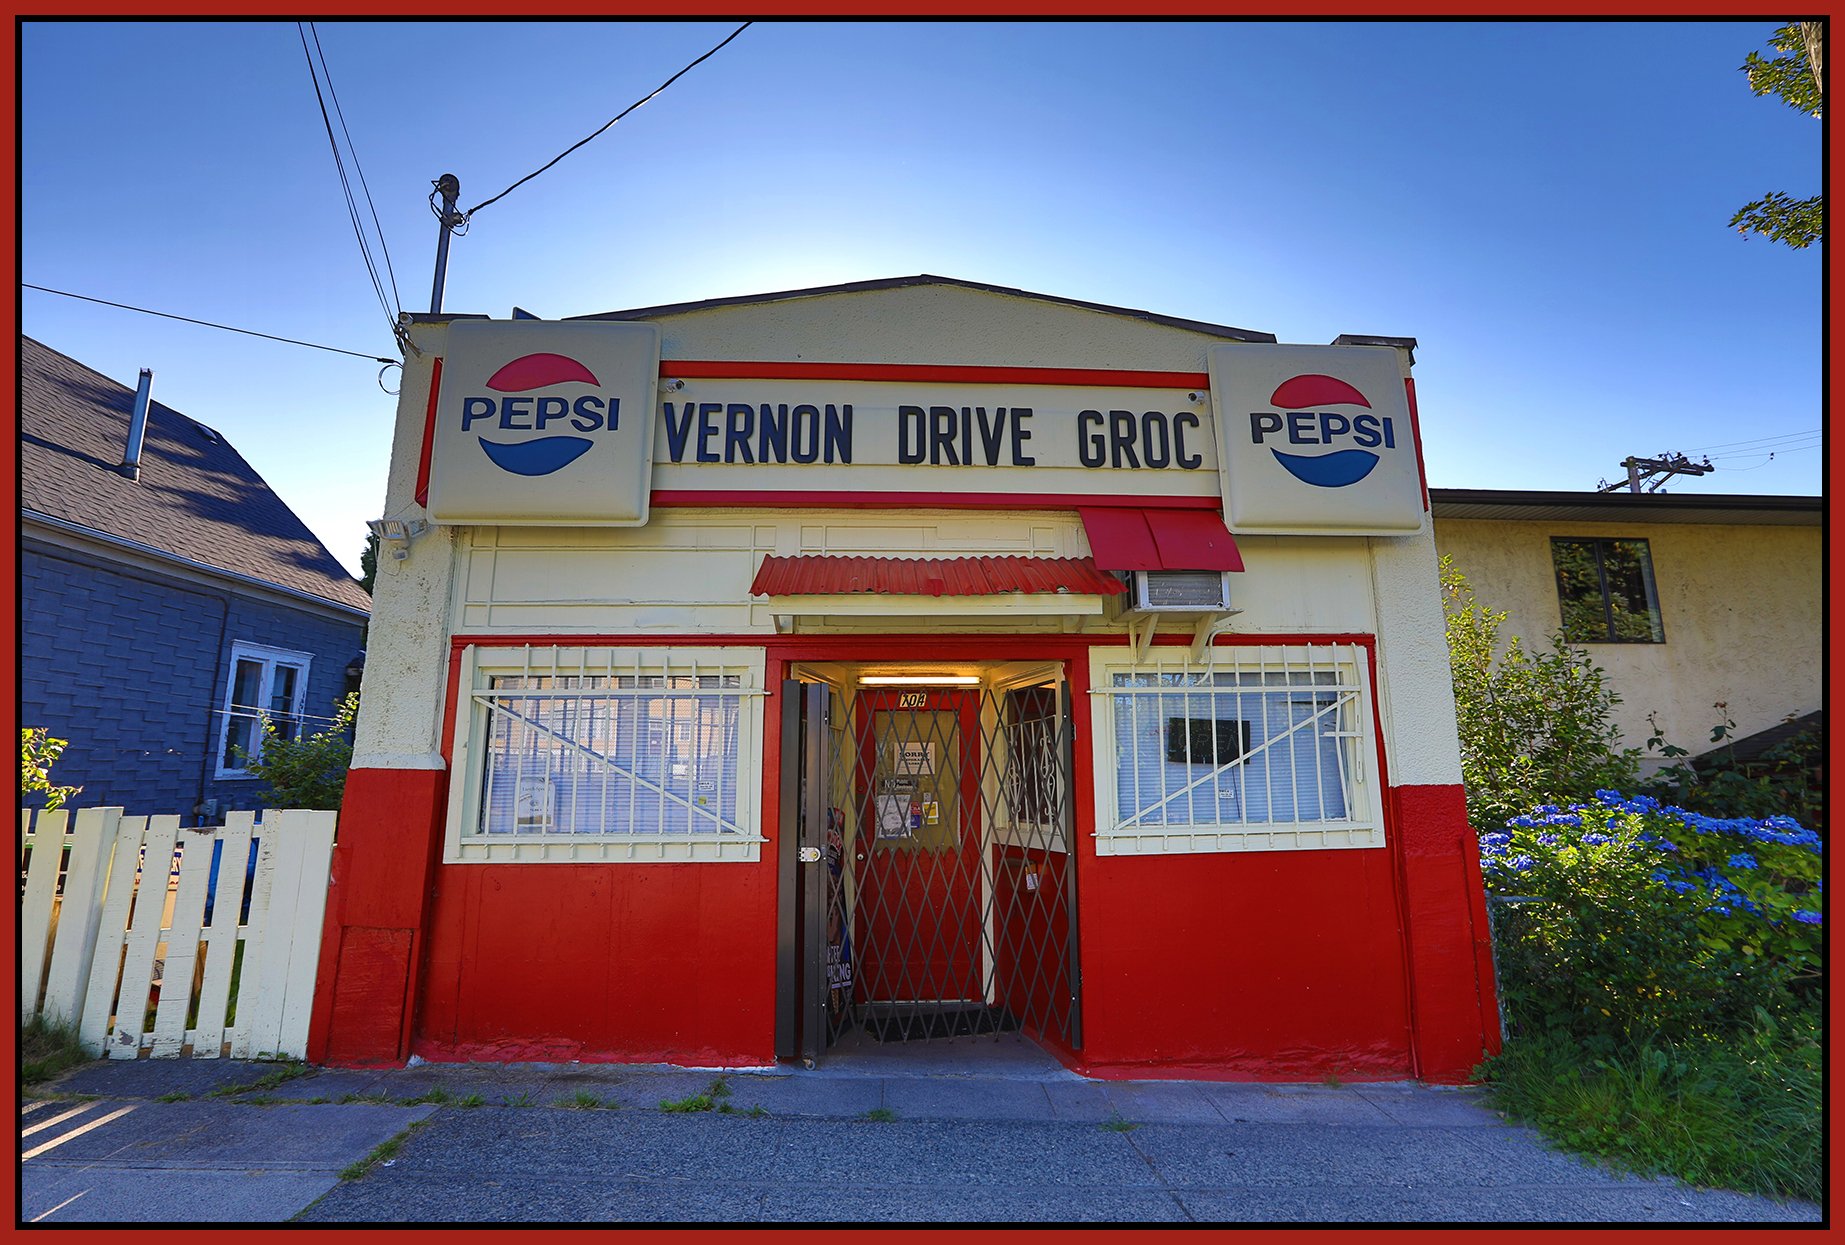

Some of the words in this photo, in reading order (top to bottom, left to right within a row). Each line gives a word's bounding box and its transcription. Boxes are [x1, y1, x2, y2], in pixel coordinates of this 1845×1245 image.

[461, 395, 621, 433] PEPSI
[1249, 412, 1396, 449] PEPSI
[663, 402, 853, 464] VERNON
[898, 405, 1036, 466] DRIVE
[1077, 410, 1203, 469] GROC
